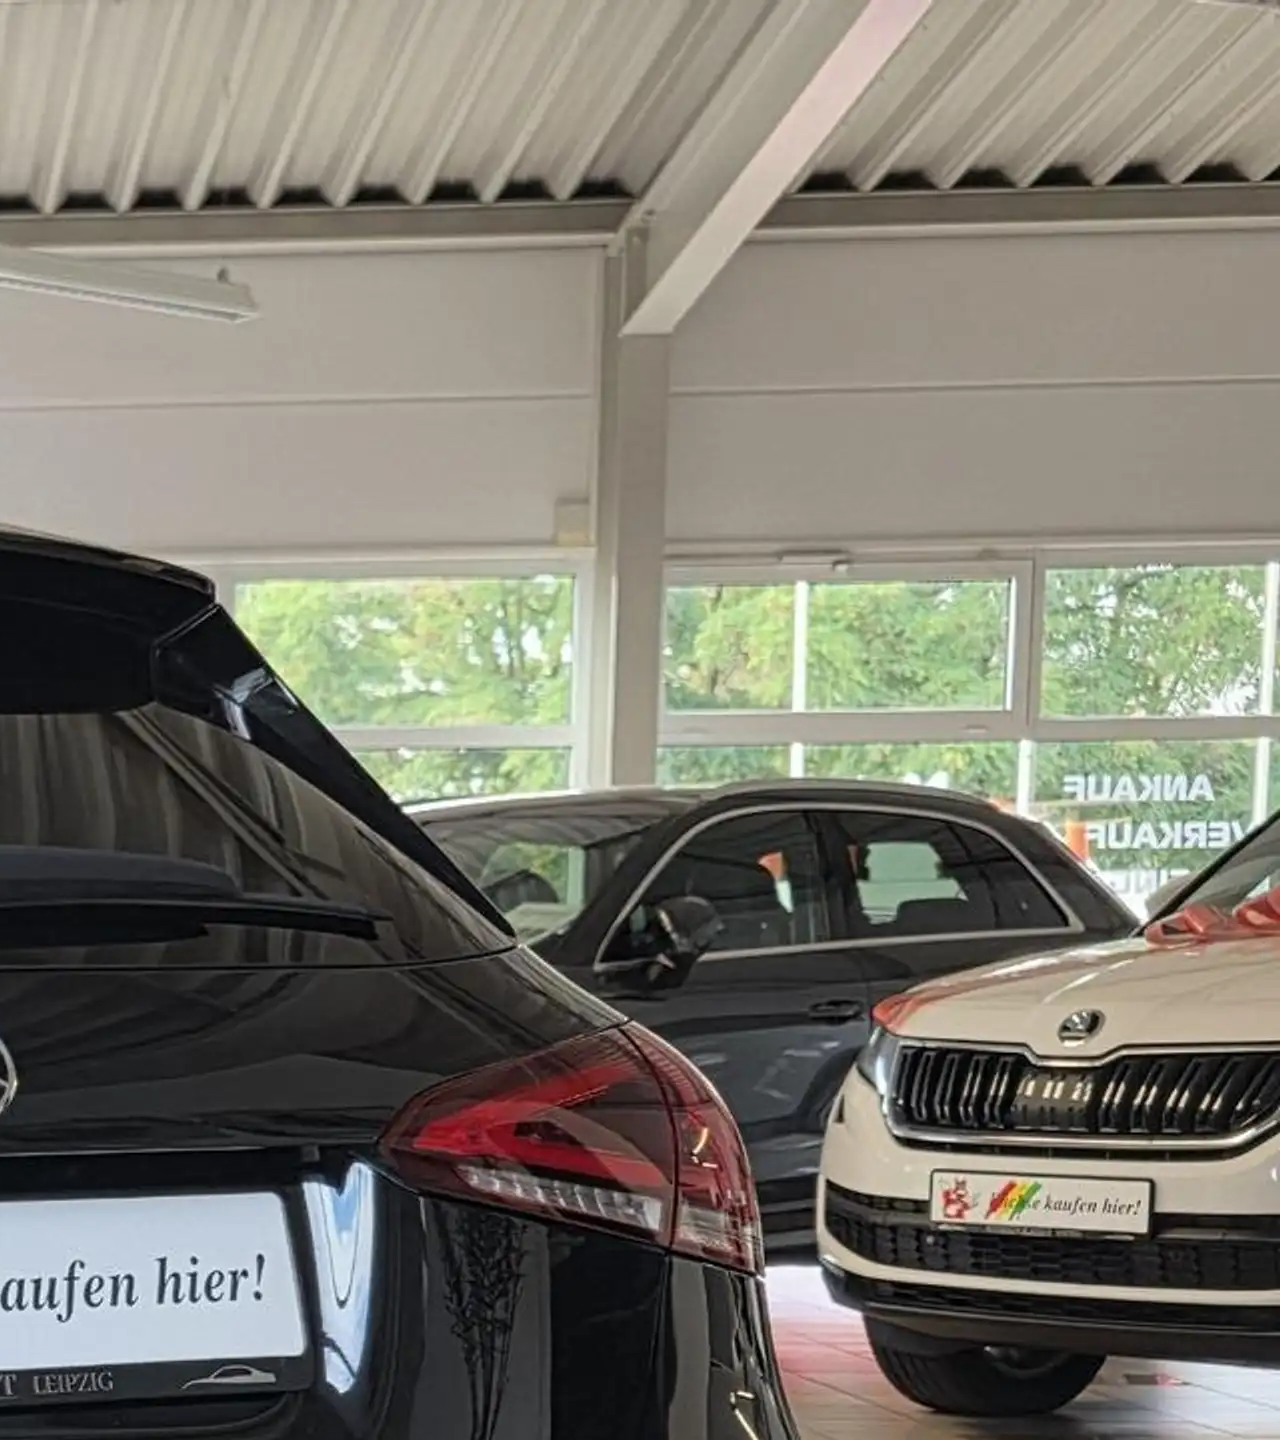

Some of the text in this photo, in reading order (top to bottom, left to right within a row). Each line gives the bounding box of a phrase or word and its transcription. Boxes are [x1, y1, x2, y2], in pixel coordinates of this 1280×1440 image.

[1044, 1194, 1098, 1216] kaufen
[1102, 1197, 1142, 1216] hier!
[154, 1253, 266, 1305] hier!
[33, 1371, 115, 1395] LEIPZIG
